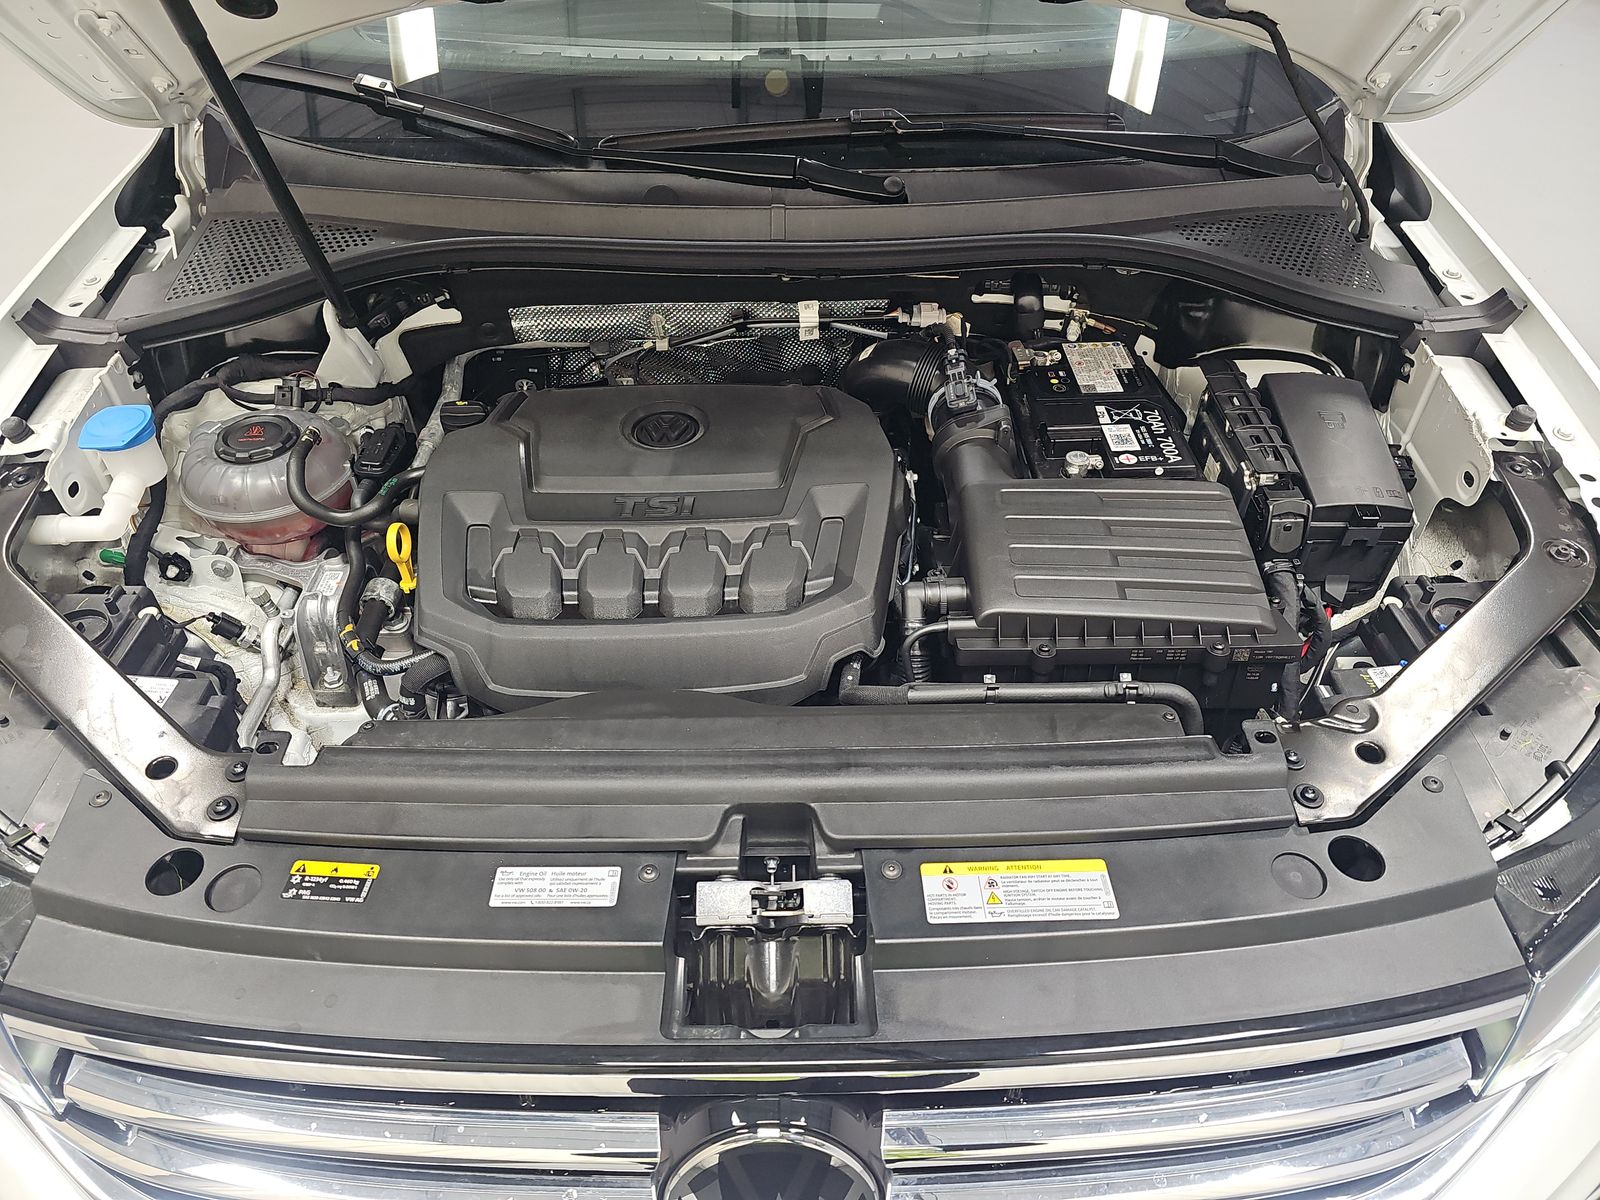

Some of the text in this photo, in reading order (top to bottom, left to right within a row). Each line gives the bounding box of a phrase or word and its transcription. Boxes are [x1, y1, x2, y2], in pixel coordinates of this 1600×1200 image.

[1144, 410, 1167, 434] 70Ah
[1157, 436, 1182, 463] 700A
[616, 495, 696, 518] TSI
